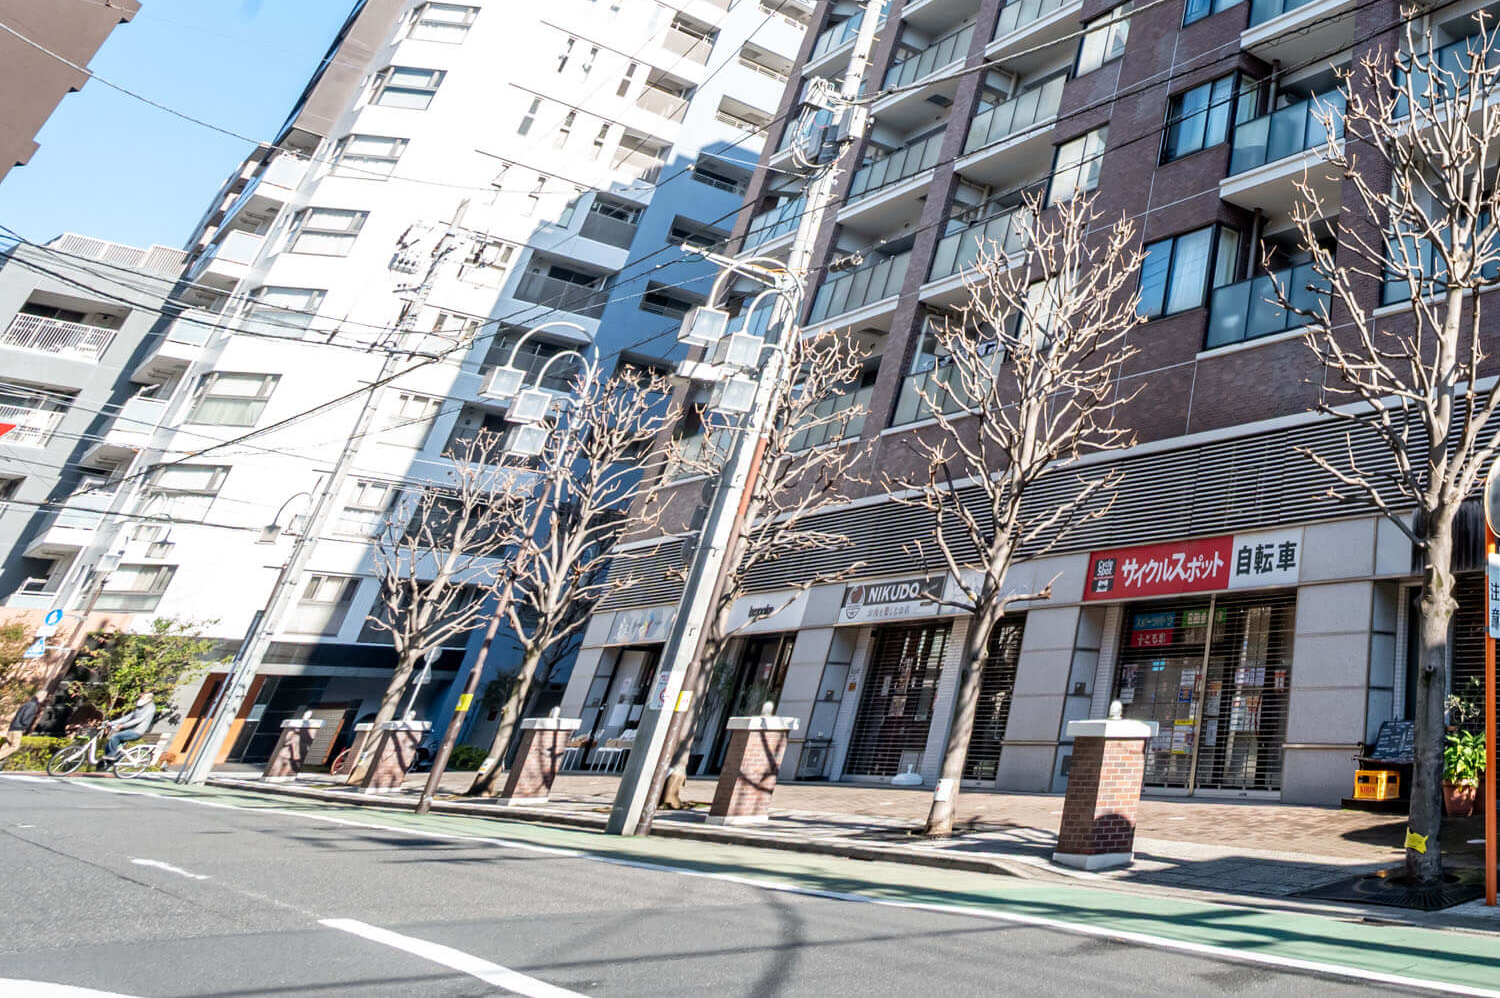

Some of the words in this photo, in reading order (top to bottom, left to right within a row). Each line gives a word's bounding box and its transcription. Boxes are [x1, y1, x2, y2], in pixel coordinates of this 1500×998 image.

[1122, 551, 1224, 587] サイクルスポット
[1236, 541, 1297, 576] 自転車
[868, 583, 920, 602] NIKUDO
[1491, 581, 1500, 630] 注意
